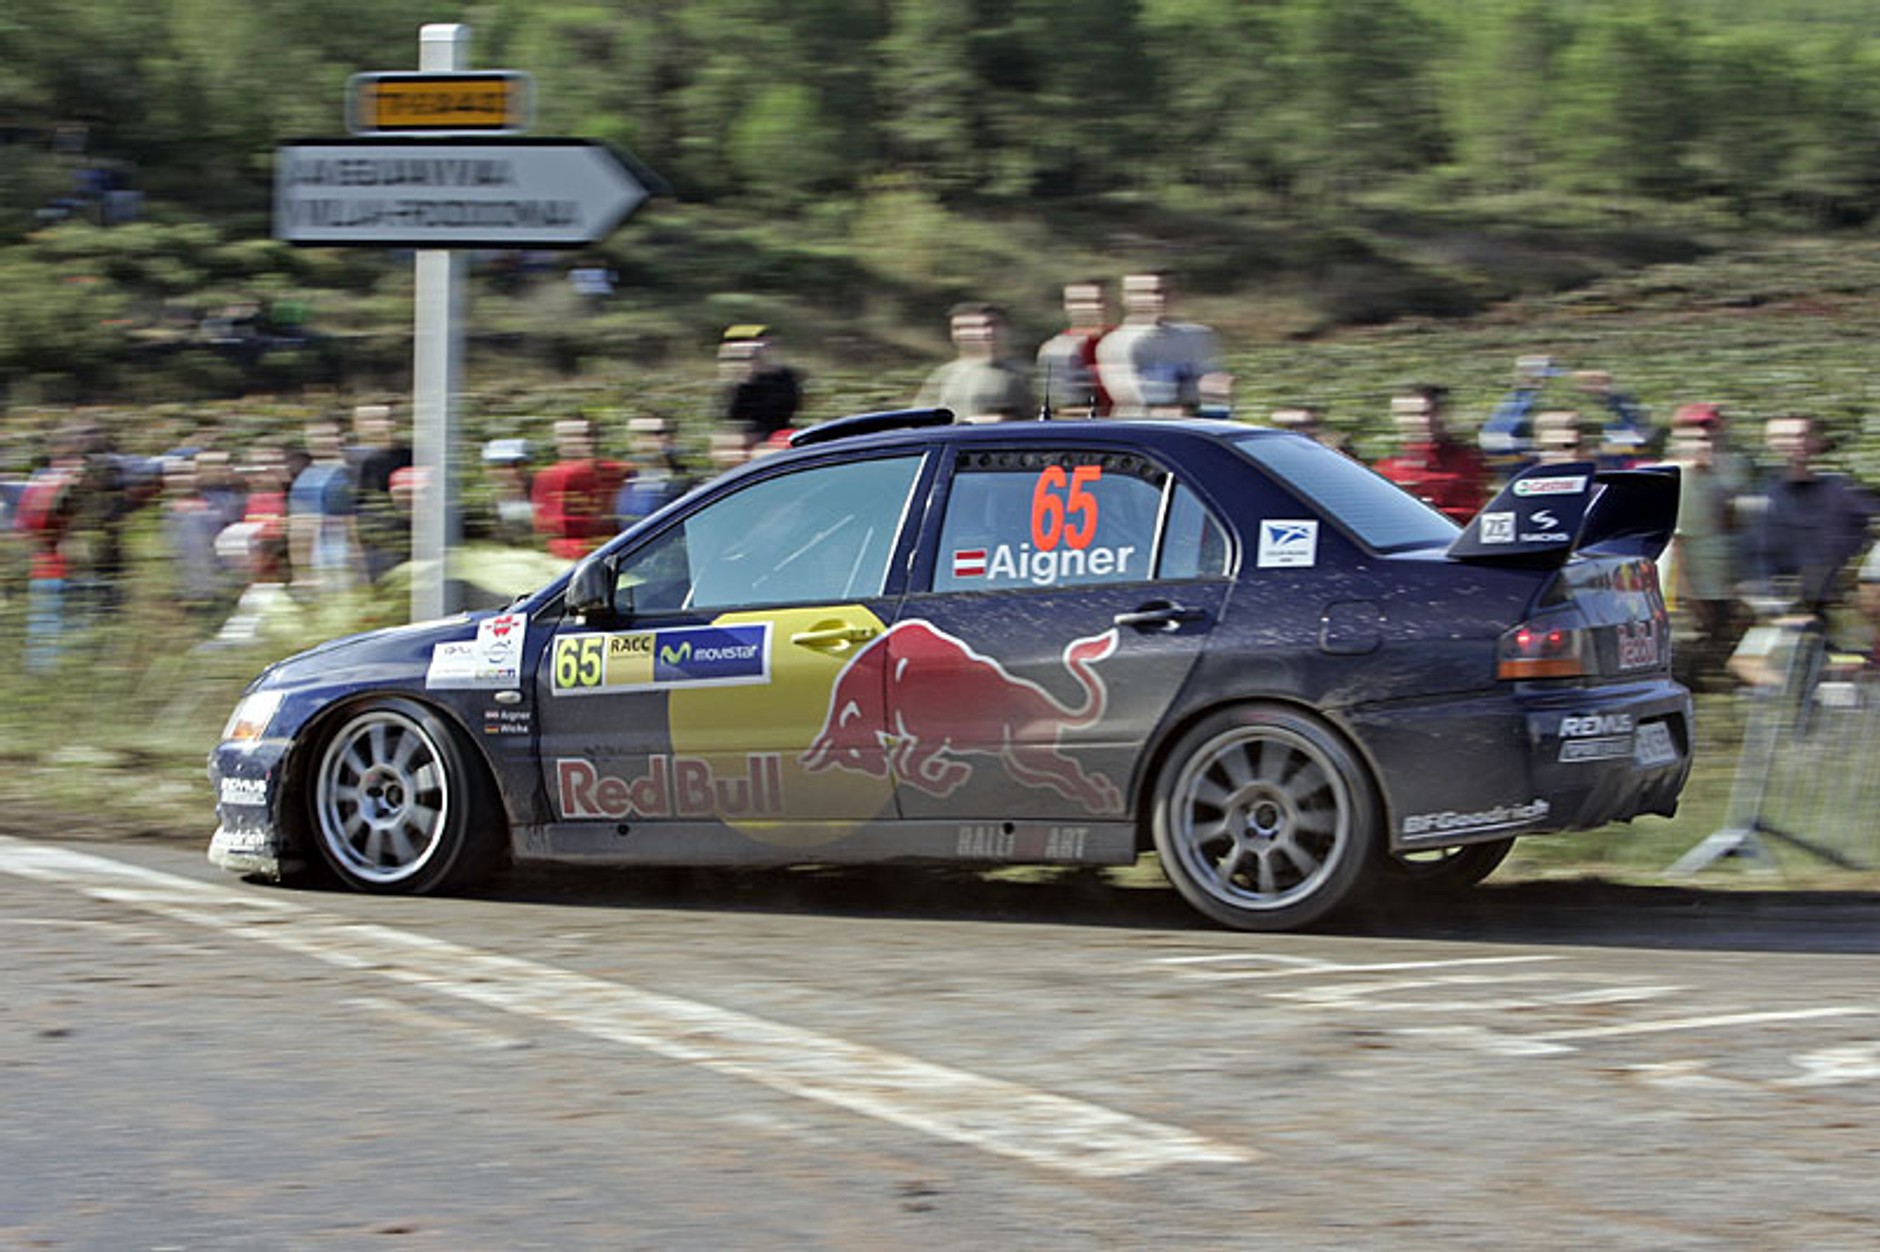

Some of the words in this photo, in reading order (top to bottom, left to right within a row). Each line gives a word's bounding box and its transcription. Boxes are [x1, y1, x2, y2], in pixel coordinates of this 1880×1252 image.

[1031, 465, 1102, 551] 65
[988, 543, 1134, 585] Aigner
[556, 639, 602, 687] 65
[610, 636, 651, 653] RACC
[694, 645, 758, 661] movistar
[557, 753, 671, 818] Red
[672, 752, 784, 817] Bull
[1403, 800, 1550, 833] BFGoodrich
